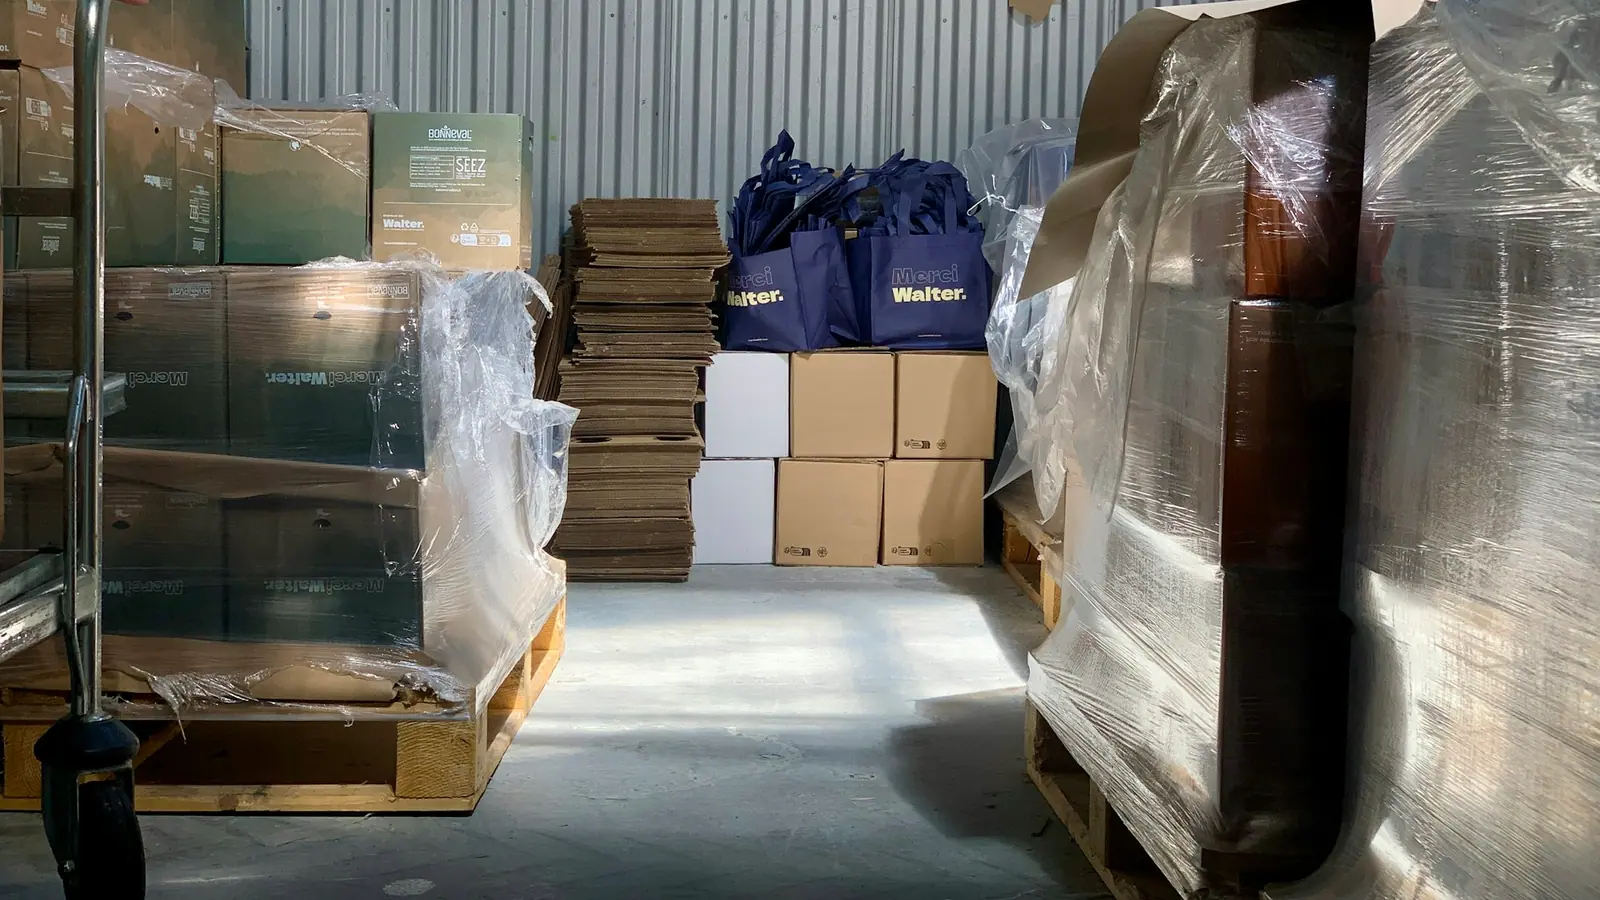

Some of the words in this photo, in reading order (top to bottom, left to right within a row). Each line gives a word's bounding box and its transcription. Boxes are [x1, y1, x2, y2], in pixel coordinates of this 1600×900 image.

[455, 158, 486, 172] SEEZ
[728, 266, 774, 289] erci
[892, 263, 960, 285] Merci
[892, 285, 967, 303] Walter.
[128, 371, 188, 388] Merci
[265, 371, 328, 387] Walter.
[328, 370, 386, 388] Merci
